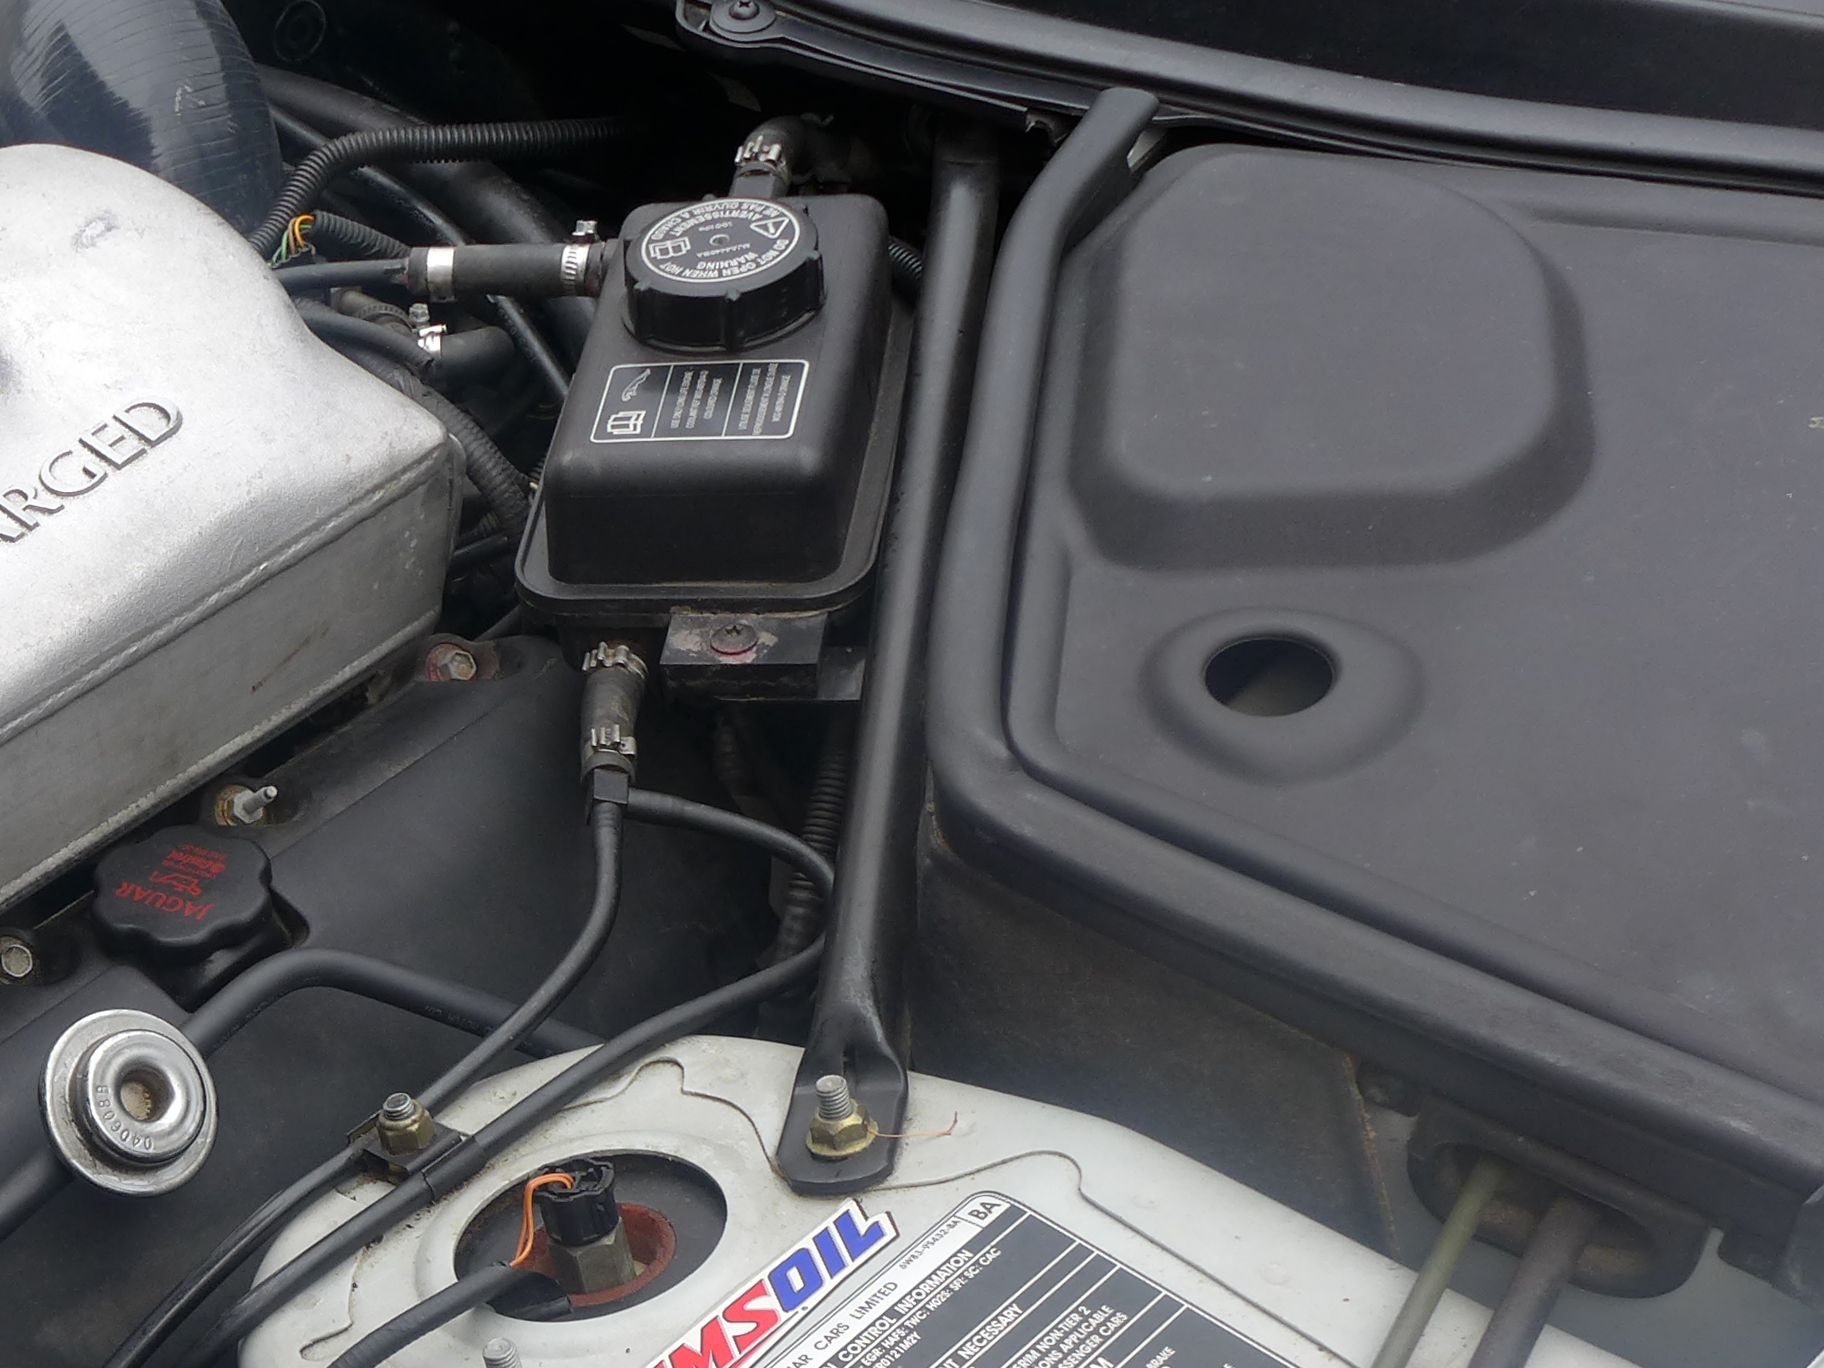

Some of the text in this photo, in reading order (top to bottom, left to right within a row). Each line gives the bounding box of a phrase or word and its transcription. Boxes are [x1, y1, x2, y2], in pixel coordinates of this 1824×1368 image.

[697, 251, 759, 270] WARNING
[722, 260, 756, 277] OPEN
[759, 248, 781, 263] NOT
[682, 264, 720, 278] WHEN
[116, 881, 215, 921] JAGUAR
[967, 1196, 1001, 1221] BA
[977, 1246, 1002, 1266] CAC
[812, 1321, 851, 1351] CARS
[849, 1279, 900, 1320] LIMITED
[836, 1313, 897, 1363] CONTROL
[893, 1248, 974, 1314] INFORMATION
[956, 1302, 1026, 1360] NECESSARY
[1034, 1312, 1084, 1352] NON-TIER
[1077, 1304, 1092, 1315] 2
[1055, 1303, 1115, 1353] APPLICABLE
[1096, 1311, 1130, 1337] CARS
